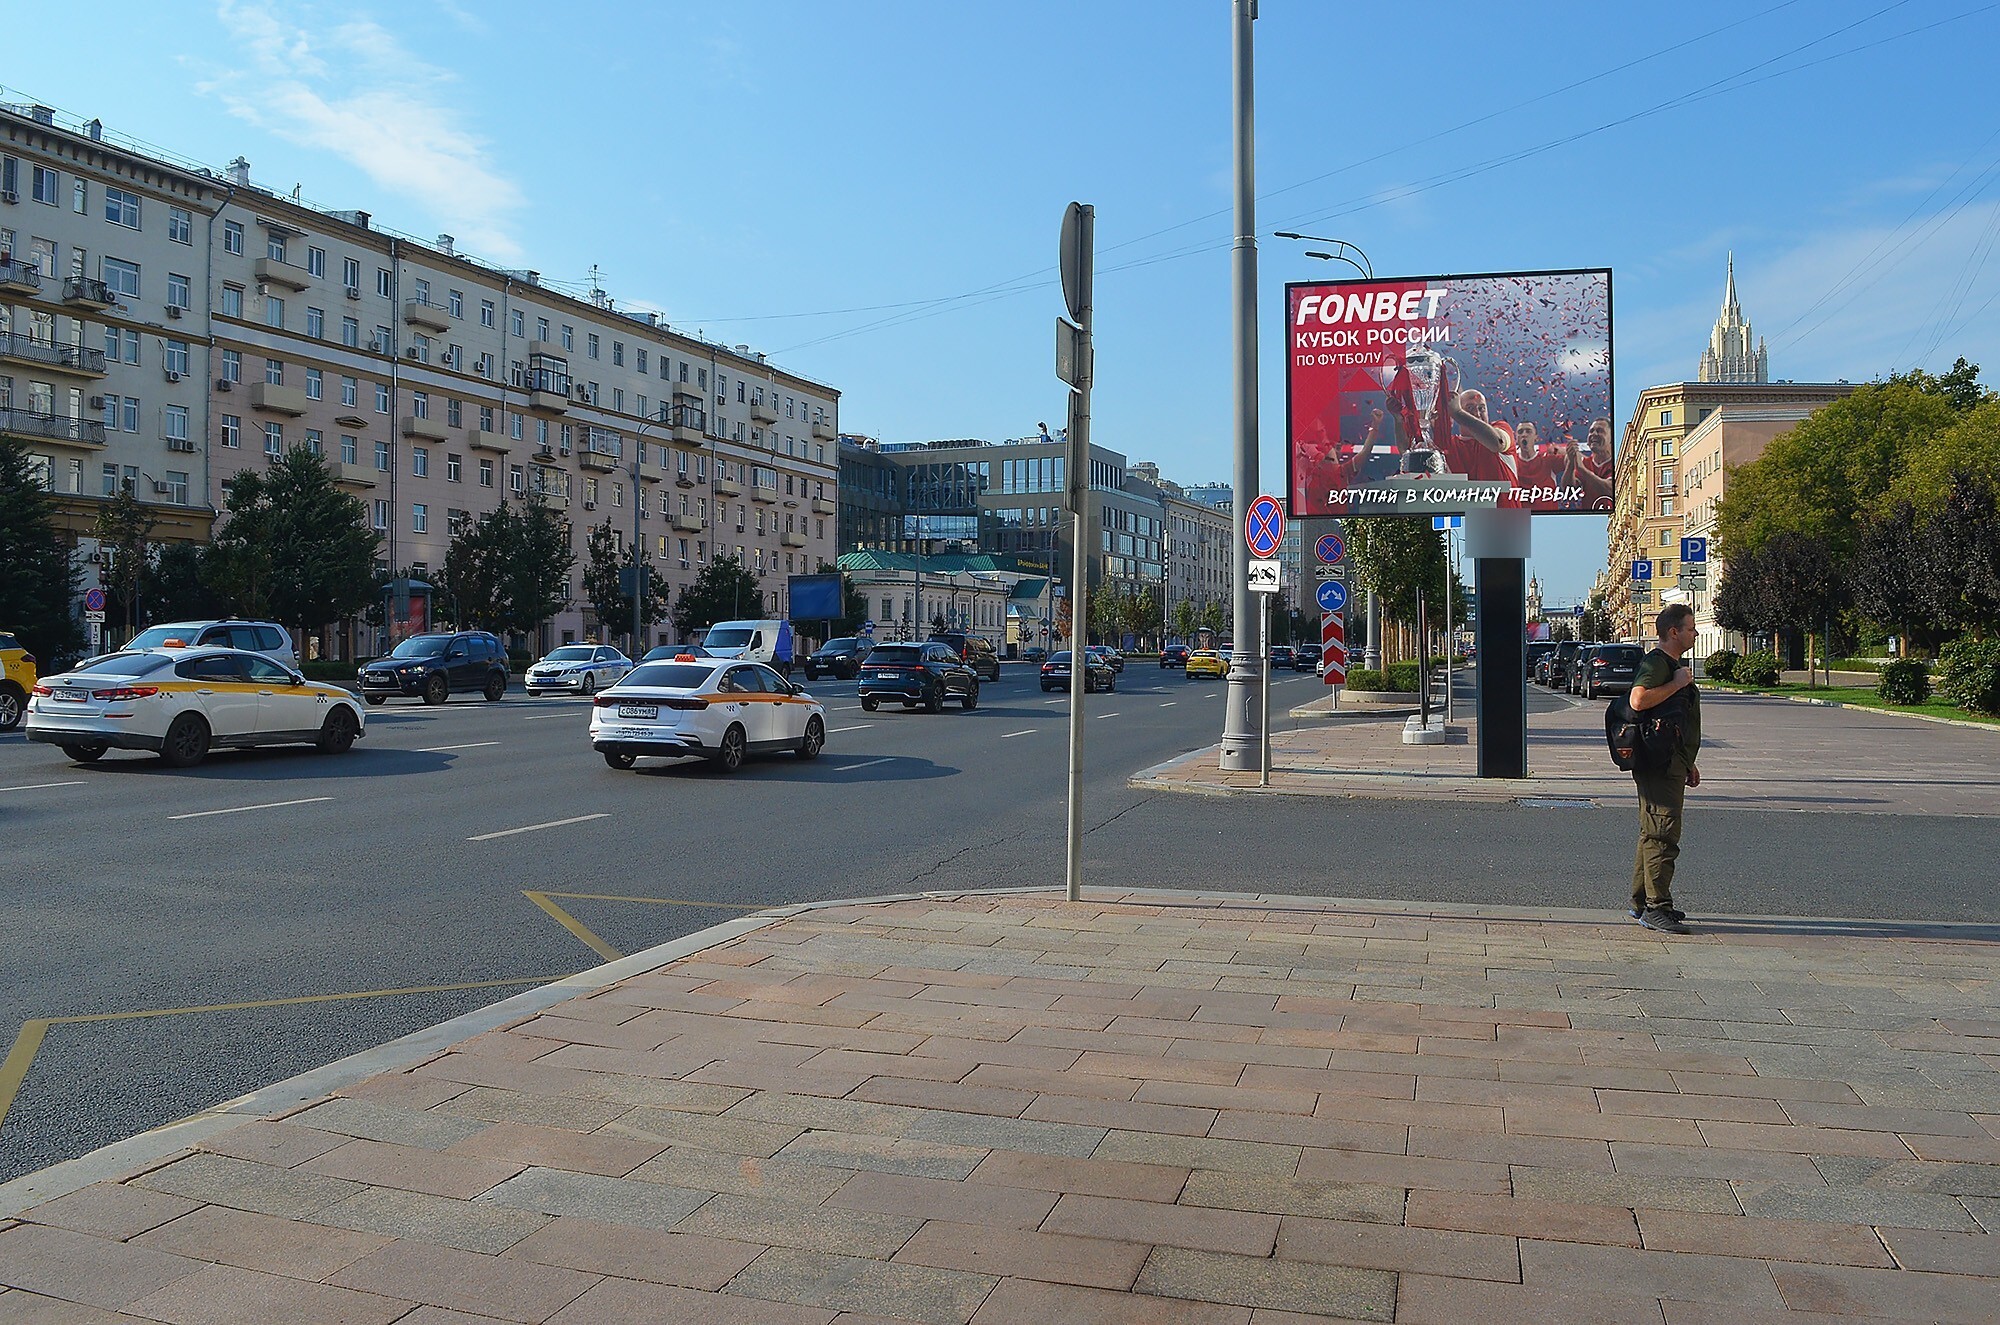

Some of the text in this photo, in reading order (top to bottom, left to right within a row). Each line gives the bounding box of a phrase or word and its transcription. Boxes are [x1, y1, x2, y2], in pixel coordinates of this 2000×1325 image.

[1296, 289, 1448, 326] FONBET
[1296, 326, 1450, 348] КУБОК РОССИИ
[1296, 352, 1382, 366] ПО ФУТБОЛУ
[1328, 489, 1400, 504] ВСТУПАЙ
[1405, 488, 1417, 503] В
[1422, 487, 1501, 503] КОМАНДУ
[1687, 540, 1702, 560] P
[1637, 562, 1649, 578] P
